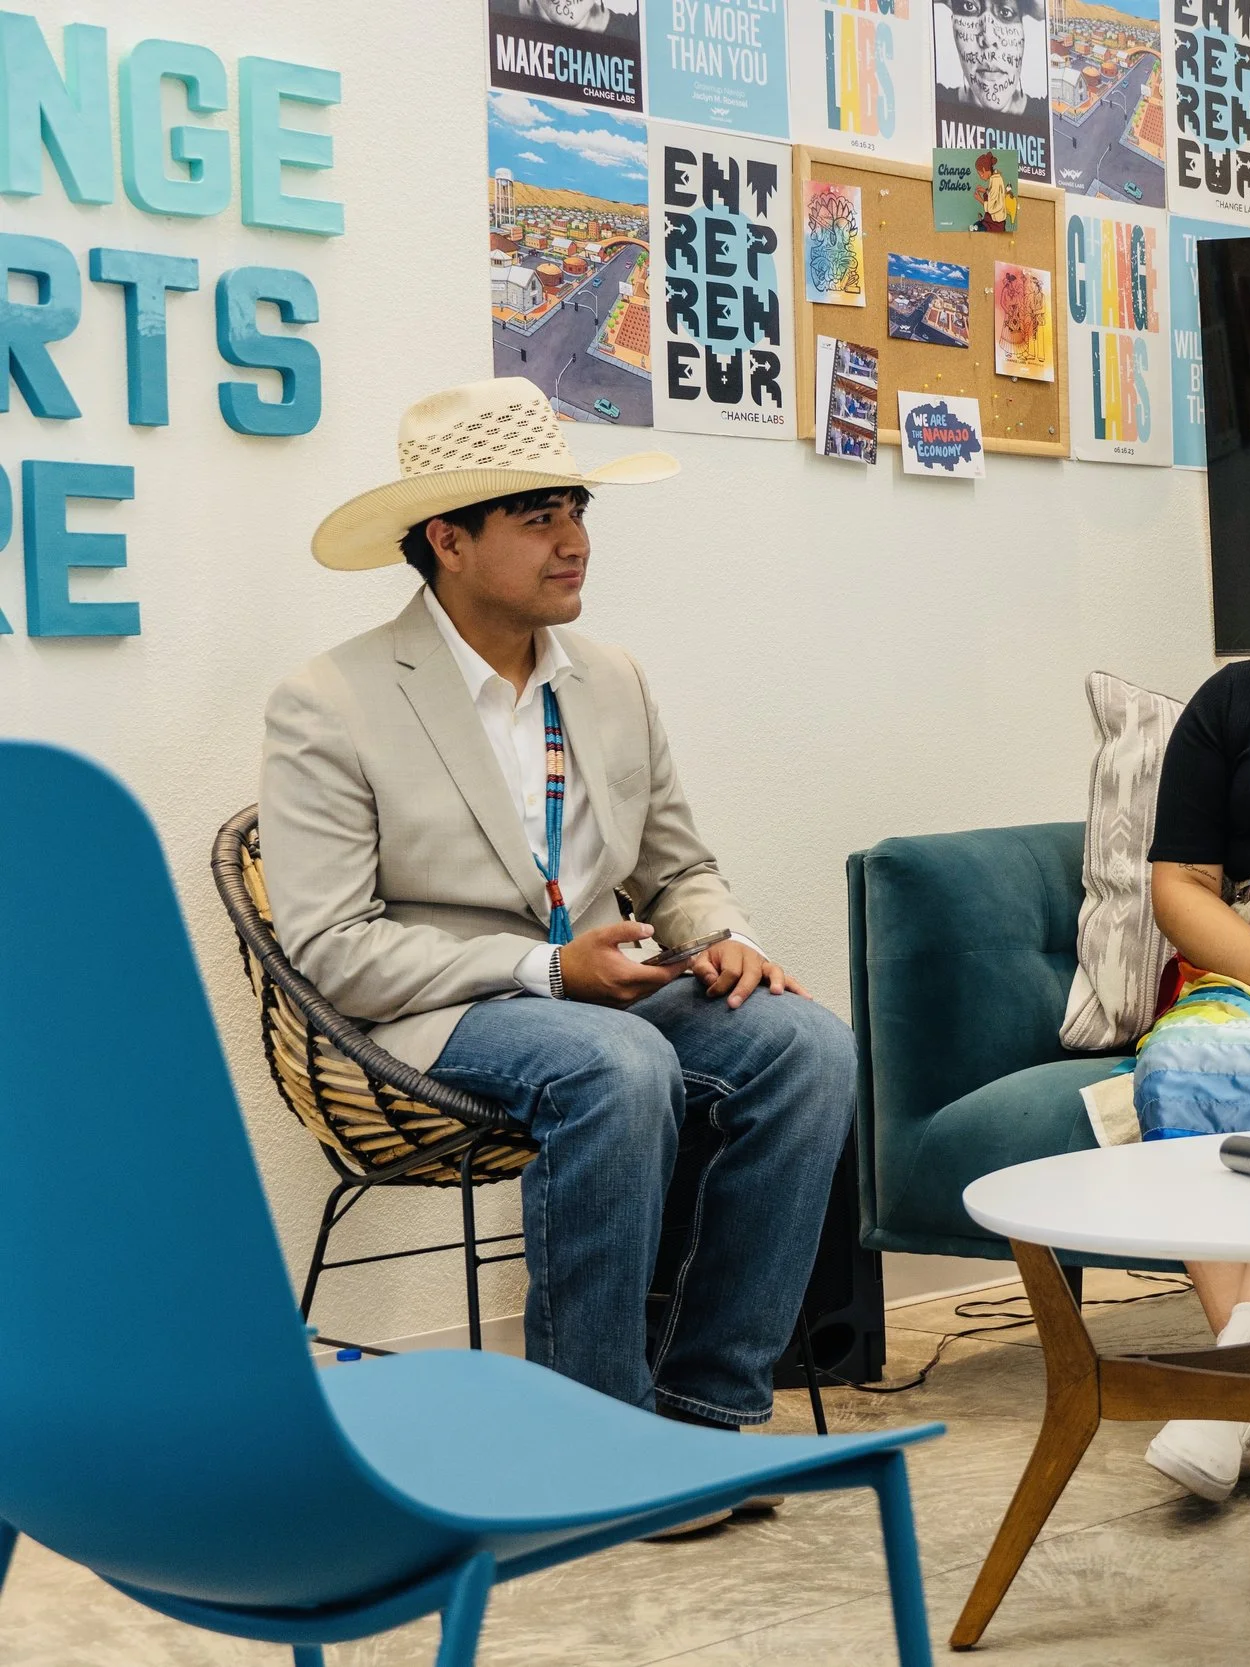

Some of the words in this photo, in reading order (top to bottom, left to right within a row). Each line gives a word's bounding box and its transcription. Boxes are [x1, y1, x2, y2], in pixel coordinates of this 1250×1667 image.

[672, 0, 699, 34] BY
[704, 3, 762, 48] MORE
[496, 33, 636, 95] MAKECHANGE
[666, 34, 723, 79] THAN
[727, 45, 768, 86] YOU
[824, 9, 896, 139] LABS
[583, 87, 615, 101] CHANGE
[616, 94, 636, 104] LABS
[664, 146, 778, 218] ENT
[938, 163, 972, 180] Change
[938, 179, 972, 192] Maker
[1018, 165, 1031, 174] NGE
[1032, 168, 1046, 177] LABS
[1216, 200, 1243, 213] CHANGE
[664, 211, 778, 281] REP
[1067, 214, 1160, 333] CHANGE
[665, 276, 781, 346] REN
[1175, 329, 1203, 360] WIL
[667, 341, 783, 408] EUR
[1091, 331, 1151, 443] LABS
[721, 410, 760, 423] CHANGE
[761, 412, 785, 425] LABS
[912, 430, 922, 439] THE
[922, 428, 969, 443] NAVAJO
[913, 413, 929, 427] WE
[930, 413, 947, 427] ARE
[917, 441, 962, 458] ECONOMY
[0, 458, 141, 638] E
